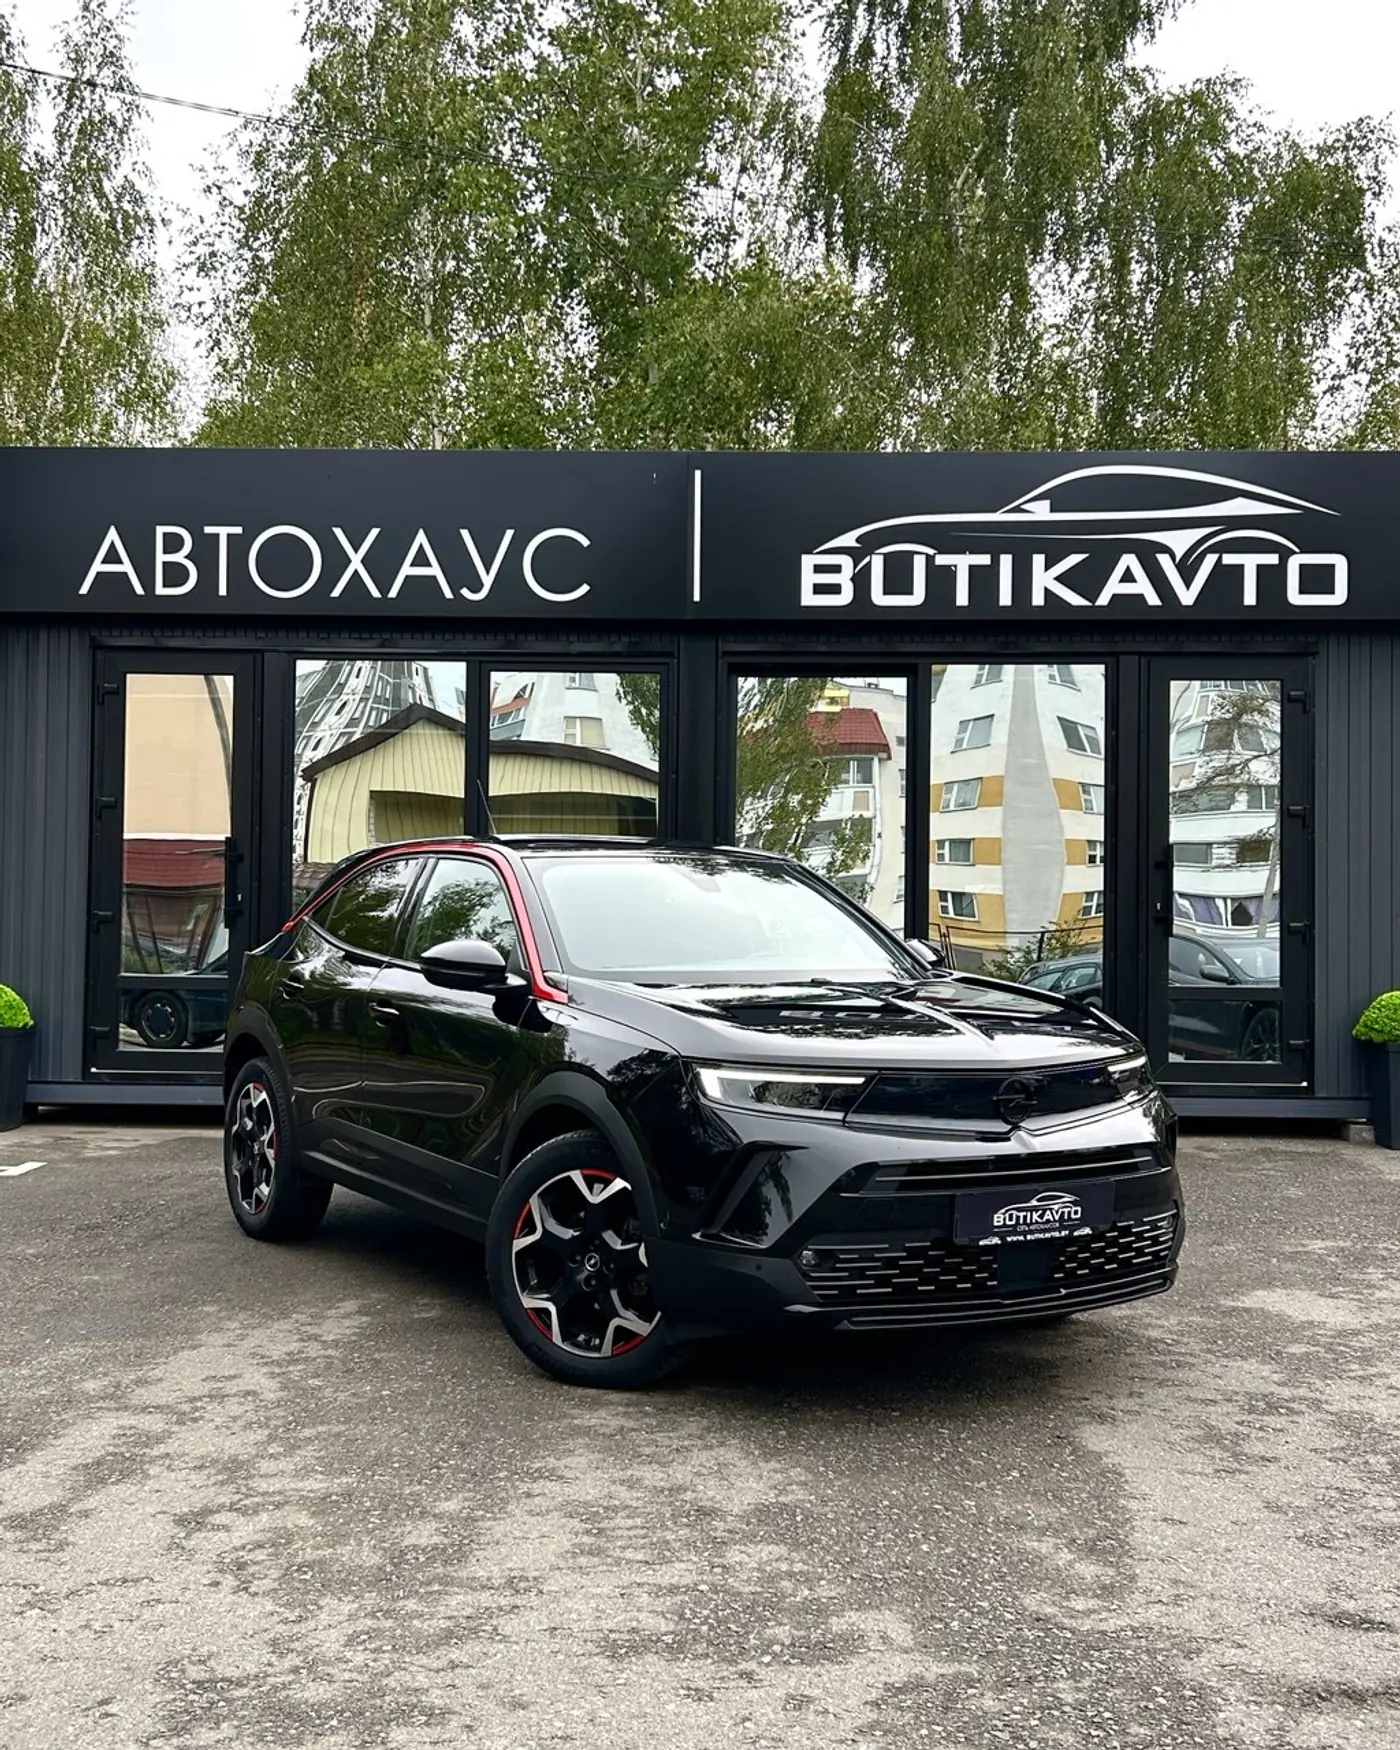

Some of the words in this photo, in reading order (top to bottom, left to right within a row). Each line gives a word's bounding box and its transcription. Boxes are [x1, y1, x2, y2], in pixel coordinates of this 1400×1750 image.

[78, 524, 591, 602] АВТОХАУС
[800, 553, 1348, 607] BUTIKAVTO
[993, 1206, 1082, 1226] BUTIKAVTO
